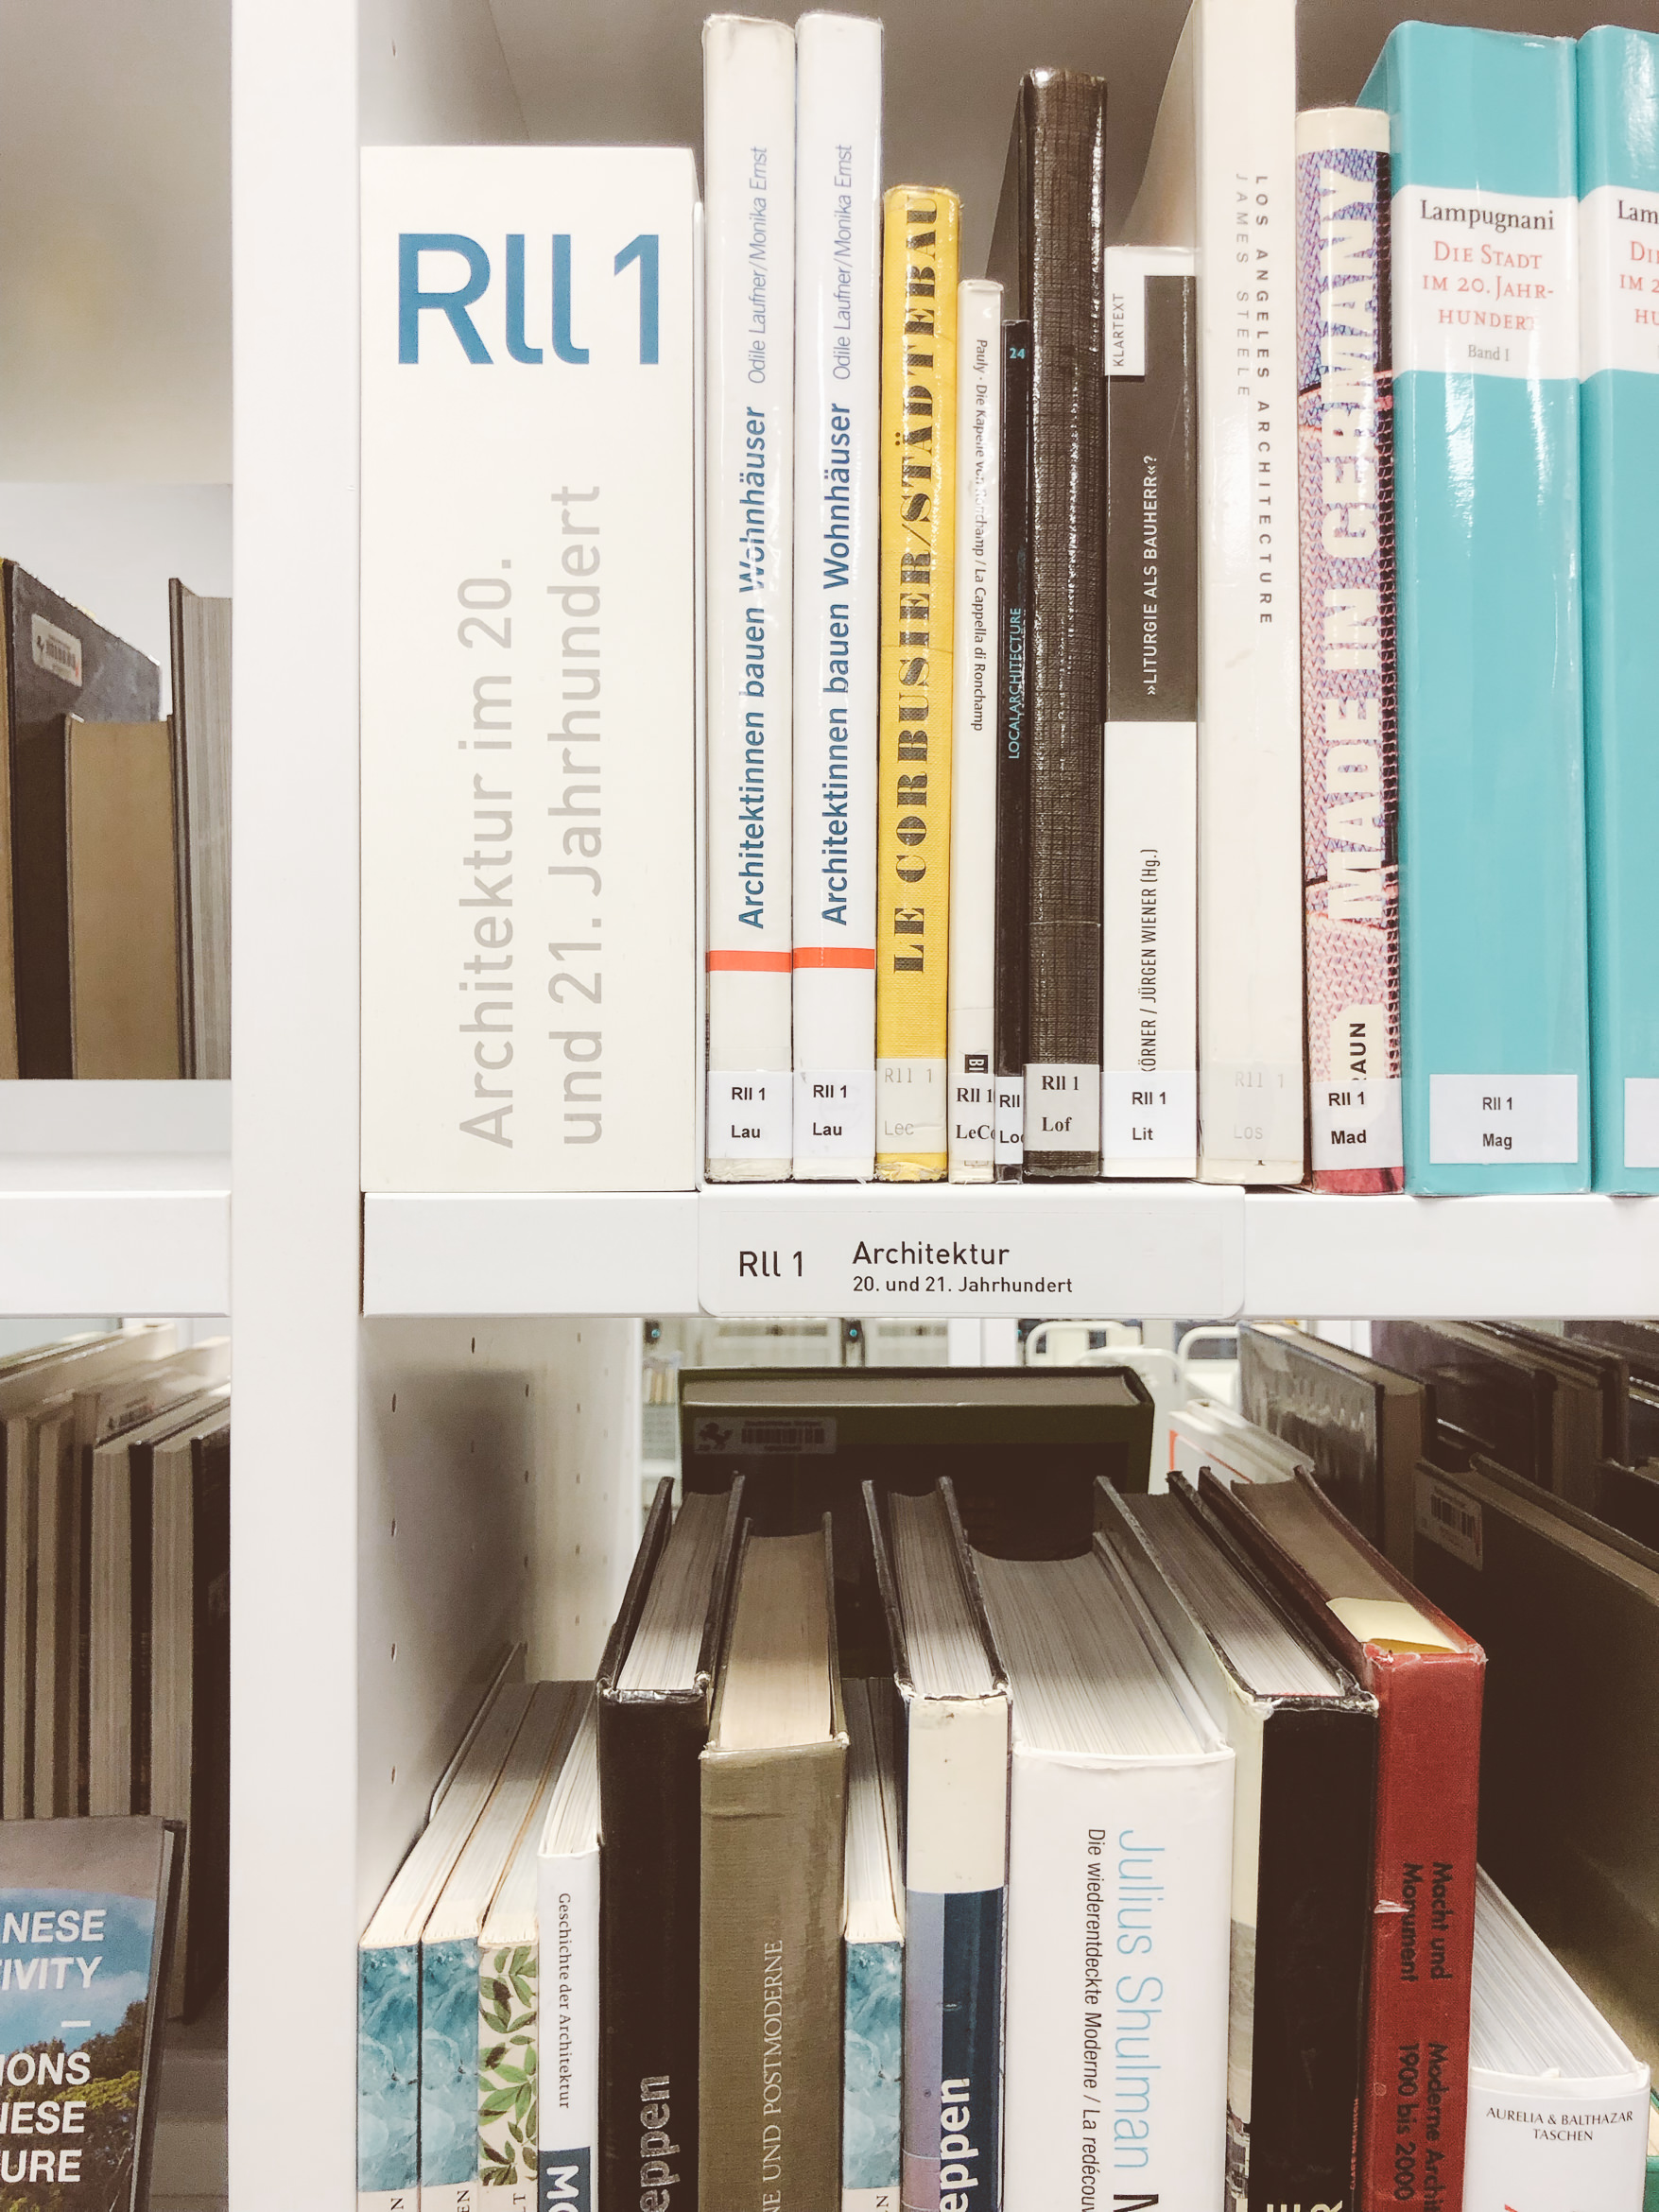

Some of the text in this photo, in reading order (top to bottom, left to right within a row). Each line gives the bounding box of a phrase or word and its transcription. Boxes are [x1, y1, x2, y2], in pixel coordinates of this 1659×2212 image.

[1420, 199, 1556, 233] Lampugnani
[748, 147, 768, 384] Odile Laufner/Monika Ernst
[832, 145, 853, 380] Odile Laufner/Monika Ernst
[613, 233, 659, 365] 1
[1236, 173, 1251, 396] JAMES STEELE
[1457, 278, 1491, 294] 20.
[1113, 293, 1124, 367] KLARTEXT
[973, 338, 988, 374] Pauly
[1009, 347, 1026, 359] 24
[1467, 344, 1500, 360] Band
[976, 385, 988, 406] Die
[1255, 175, 1272, 624] LOS ANGELES ARCHITECTURE
[1320, 167, 1383, 920] MADE IN GERMANY
[975, 568, 987, 582] La
[1143, 565, 1157, 599] ALS
[972, 587, 986, 645] Cappella
[737, 406, 767, 930] Architektinnen bauen Wohnhäuser
[821, 403, 851, 926] Architektinnen bauen Wohnhäuser
[975, 647, 986, 660] di
[971, 664, 986, 732] Ronchamp
[1008, 607, 1022, 759] LOCALARCHITECTURE
[545, 485, 603, 1145] und 21. Jahrhundert
[457, 559, 514, 1149] Architektur im 20.
[1140, 888, 1157, 943] WIENER
[893, 907, 925, 974] LE
[1137, 948, 1157, 1004] JÜRGEN
[840, 1084, 847, 1098] 1
[926, 1068, 932, 1083] 1
[1073, 1076, 1079, 1091] 1
[758, 1087, 765, 1100] 1
[986, 1088, 993, 1103] 1
[1159, 1091, 1166, 1105] 1
[1357, 1091, 1365, 1105] 1
[1506, 1097, 1512, 1111] 1
[731, 1124, 761, 1138] Lau
[813, 1121, 842, 1136] Lau
[884, 1120, 915, 1135] Lec
[1041, 1116, 1073, 1132] Lof
[1132, 1127, 1153, 1141] Lit
[1331, 1130, 1367, 1144] Mad
[1482, 1133, 1512, 1150] Mag
[792, 1250, 804, 1277] 1
[852, 1240, 1011, 1265] Architektur
[853, 1275, 1073, 1293] 20. und 21. Jahrhundert
[1087, 1828, 1106, 1856] Die
[1116, 1829, 1165, 1955] Julius
[1084, 1862, 1104, 2005] wiederentdeckte
[1400, 1862, 1425, 1983] Monument
[1430, 1862, 1454, 1980] Macht und
[558, 1892, 572, 2109] Geschichte der Architektur
[763, 1940, 784, 2117] POSTMODERNE
[1083, 2012, 1102, 2090] Moderne
[1114, 1976, 1164, 2169] Shulman
[1425, 2042, 1449, 2142] Moderne
[1081, 2108, 1100, 2131] La
[1392, 2045, 1420, 2201] 1900 bis 2000
[1486, 2107, 1633, 2126] AURELIA & BALTHAZAR
[1532, 2128, 1594, 2141] TASCHEN
[762, 2123, 783, 2183] UND
